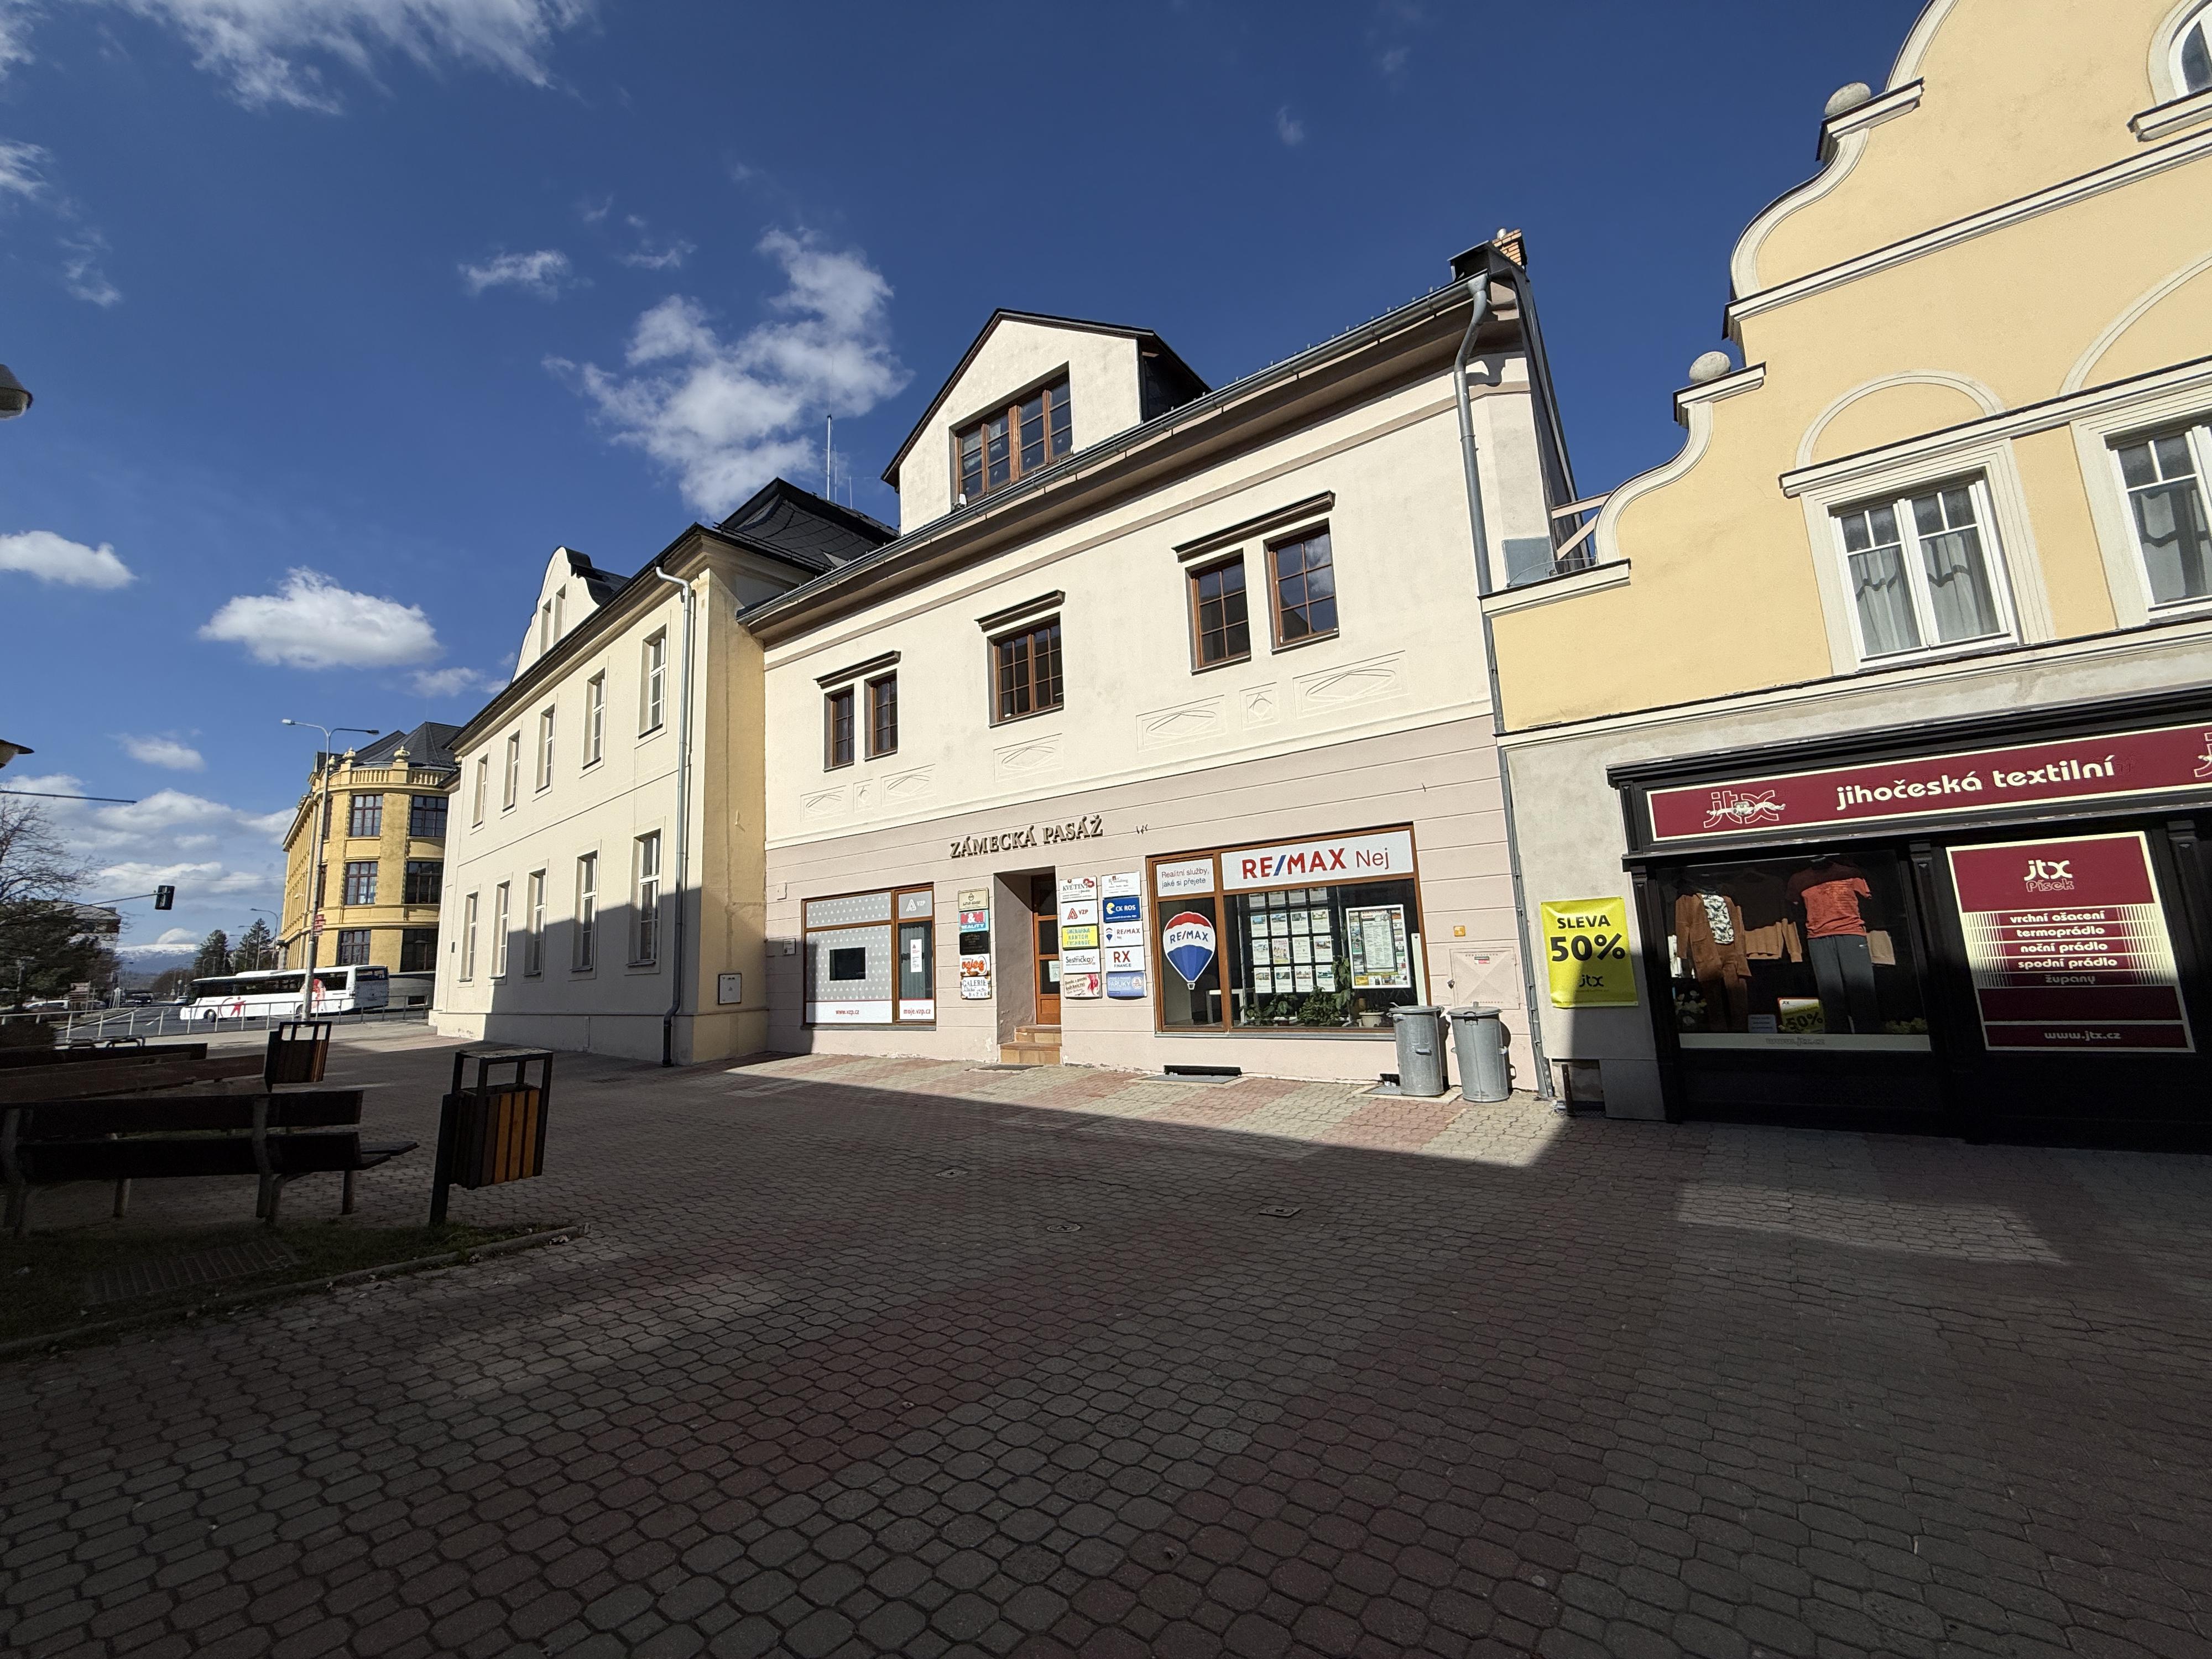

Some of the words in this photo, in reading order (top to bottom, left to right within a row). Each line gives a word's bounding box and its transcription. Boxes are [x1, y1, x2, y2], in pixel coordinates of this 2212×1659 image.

[1837, 771, 1983, 810] jihočeská
[1993, 755, 2115, 788] textilní
[950, 825, 1037, 858] ZÁMECKÁ
[1042, 815, 1103, 844] PASÁŽ
[1242, 847, 1347, 879] RE/MAX
[1355, 847, 1389, 870] Nej
[1161, 869, 1185, 878] Realitní
[2023, 859, 2073, 881] jtx
[1162, 879, 1175, 889] jaké
[1183, 878, 1206, 886] přejete
[2026, 878, 2074, 892] Písek
[1557, 915, 1611, 929] SLEVA
[2010, 913, 2049, 924] vrchní
[2052, 910, 2105, 921] ošacení
[1170, 930, 1208, 943] RE/MAX
[2016, 926, 2105, 938] termoprádlo
[1550, 933, 1626, 962] 50%
[2020, 943, 2056, 953] noční
[2059, 941, 2108, 953] prádlo
[1113, 951, 1131, 963] RX
[2018, 958, 2065, 970] spodní
[2068, 957, 2118, 969] prádlo
[1579, 974, 1604, 987] jtx
[2045, 974, 2096, 984] župany
[2044, 1030, 2121, 1041] www.jtx.cz
